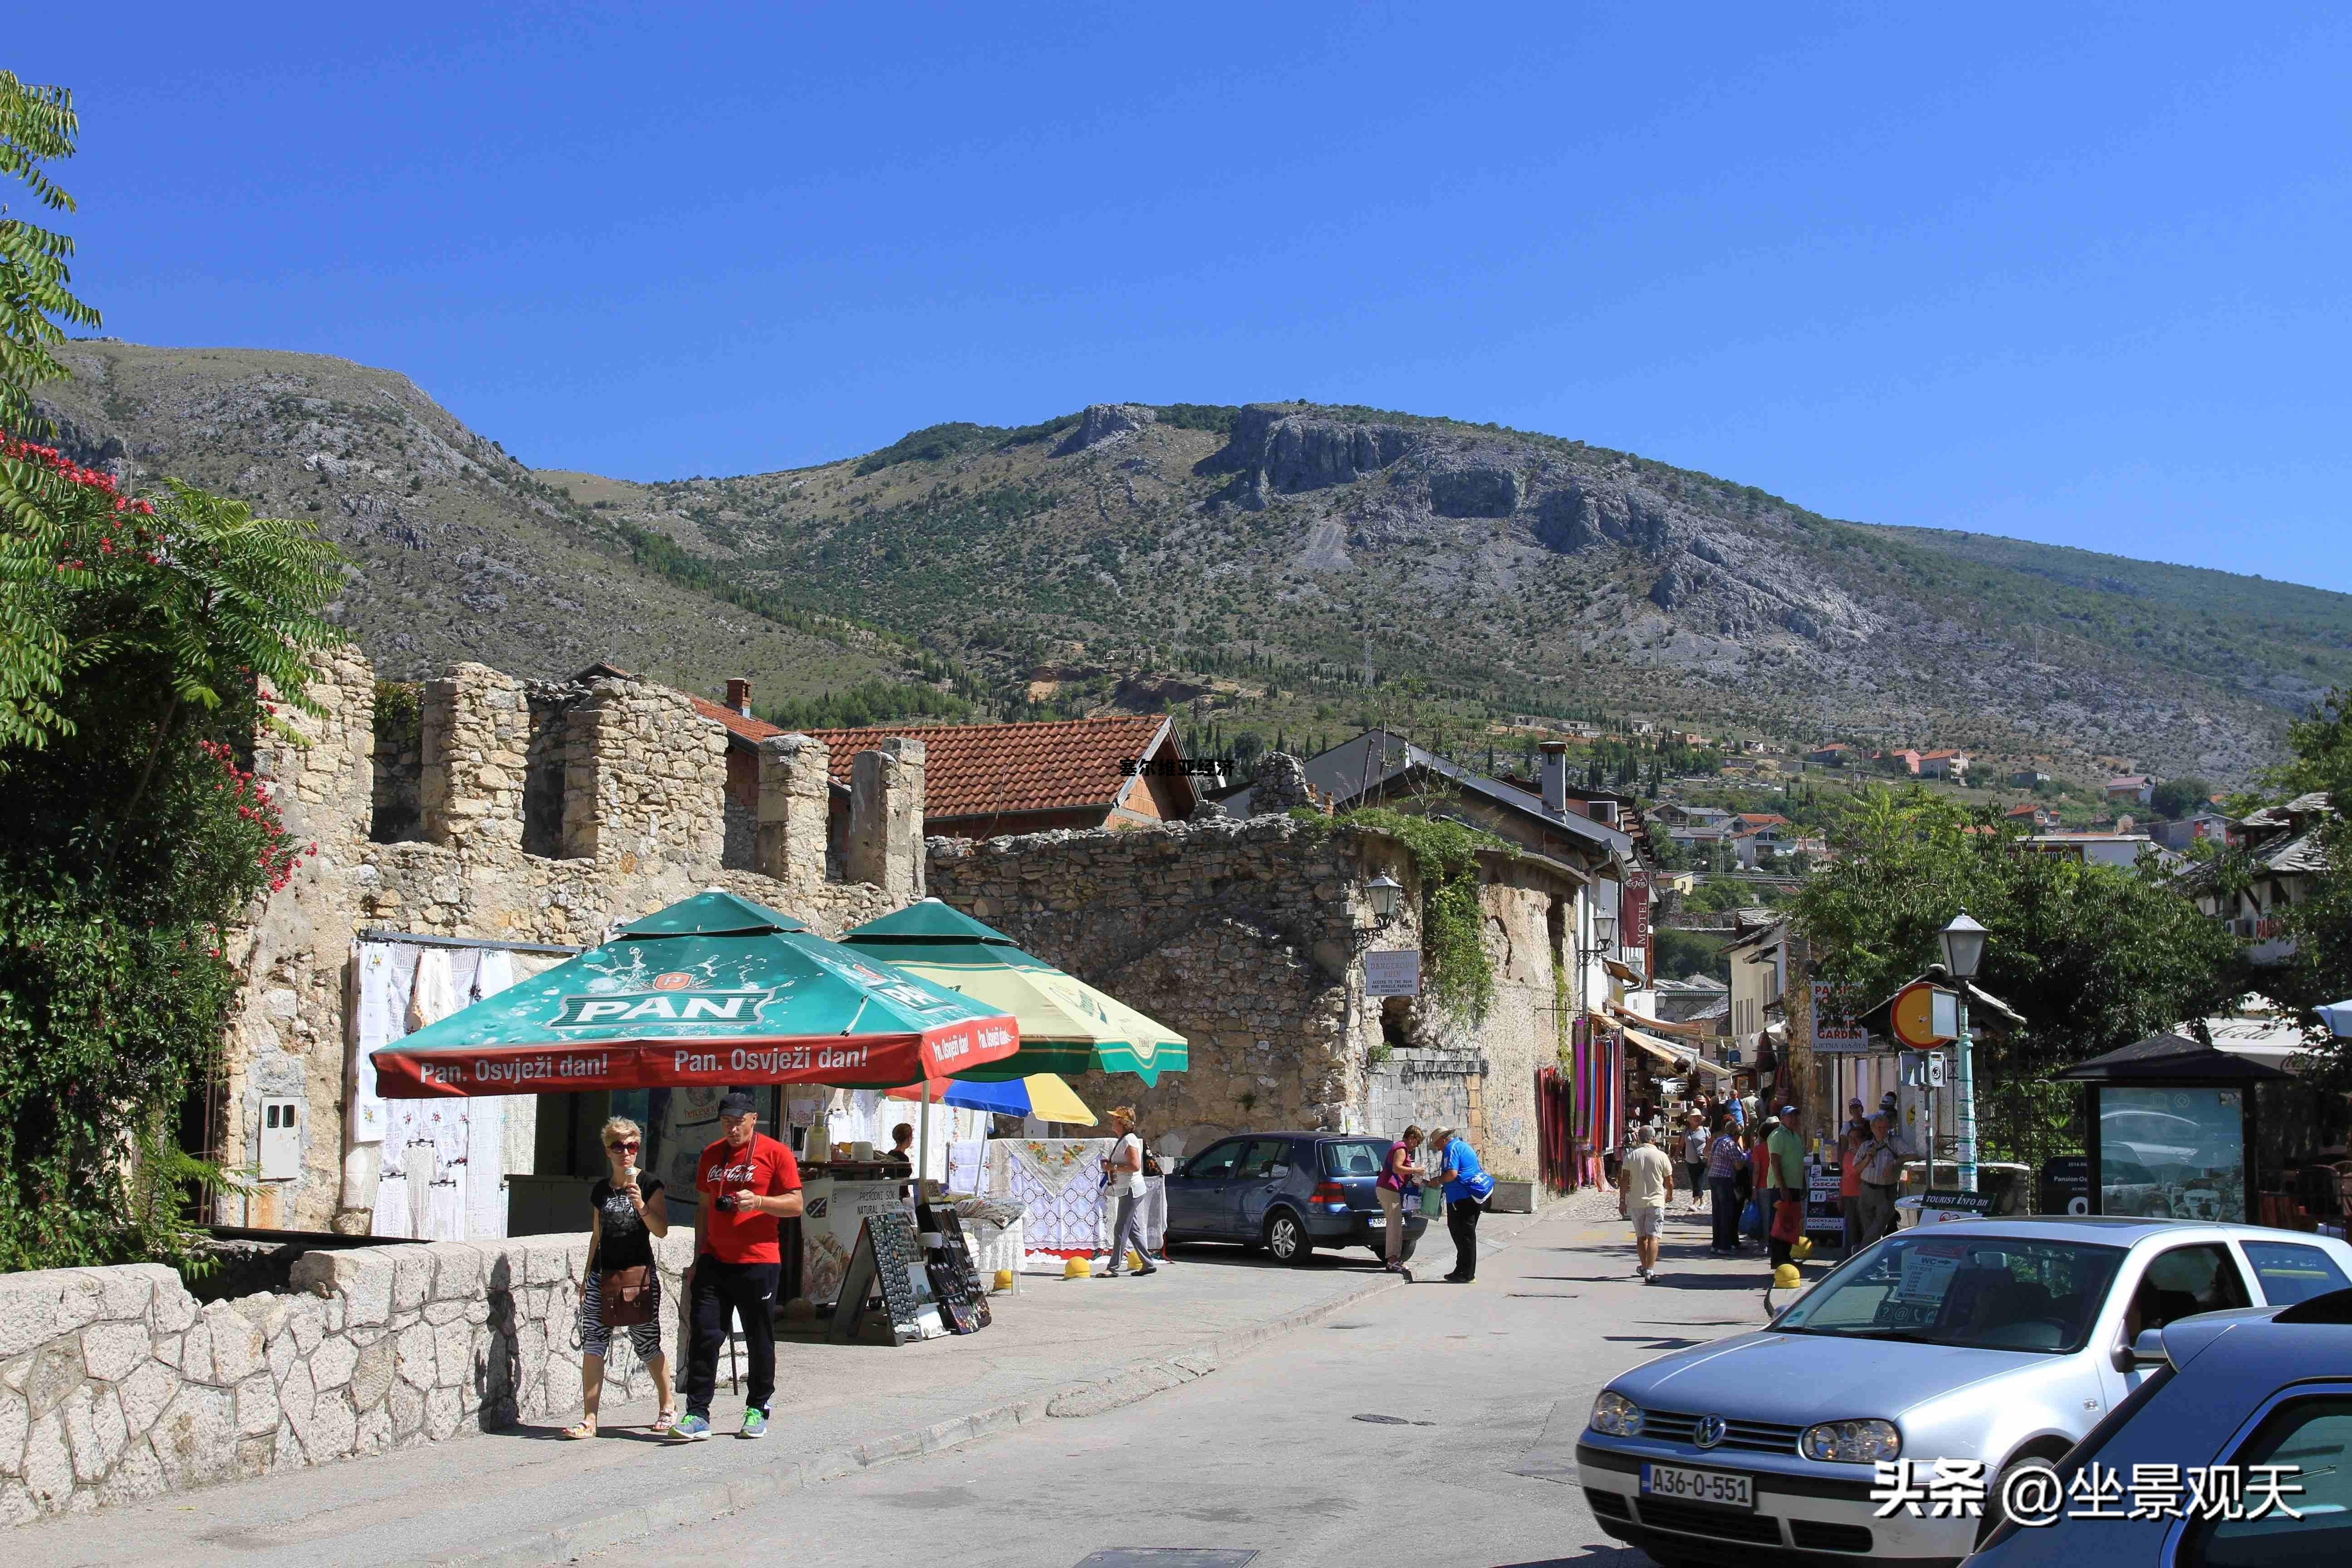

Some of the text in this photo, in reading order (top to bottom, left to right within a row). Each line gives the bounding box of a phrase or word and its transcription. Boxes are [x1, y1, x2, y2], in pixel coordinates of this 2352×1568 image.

[1637, 899, 1647, 944] MOTEL
[573, 996, 748, 1022] PAN
[421, 1053, 608, 1084] Pan. Osvježi dan!
[675, 1046, 867, 1074] Pan. Osvježi dan!
[857, 1205, 878, 1215] NATURAL
[1926, 1196, 1956, 1204] TOURIST
